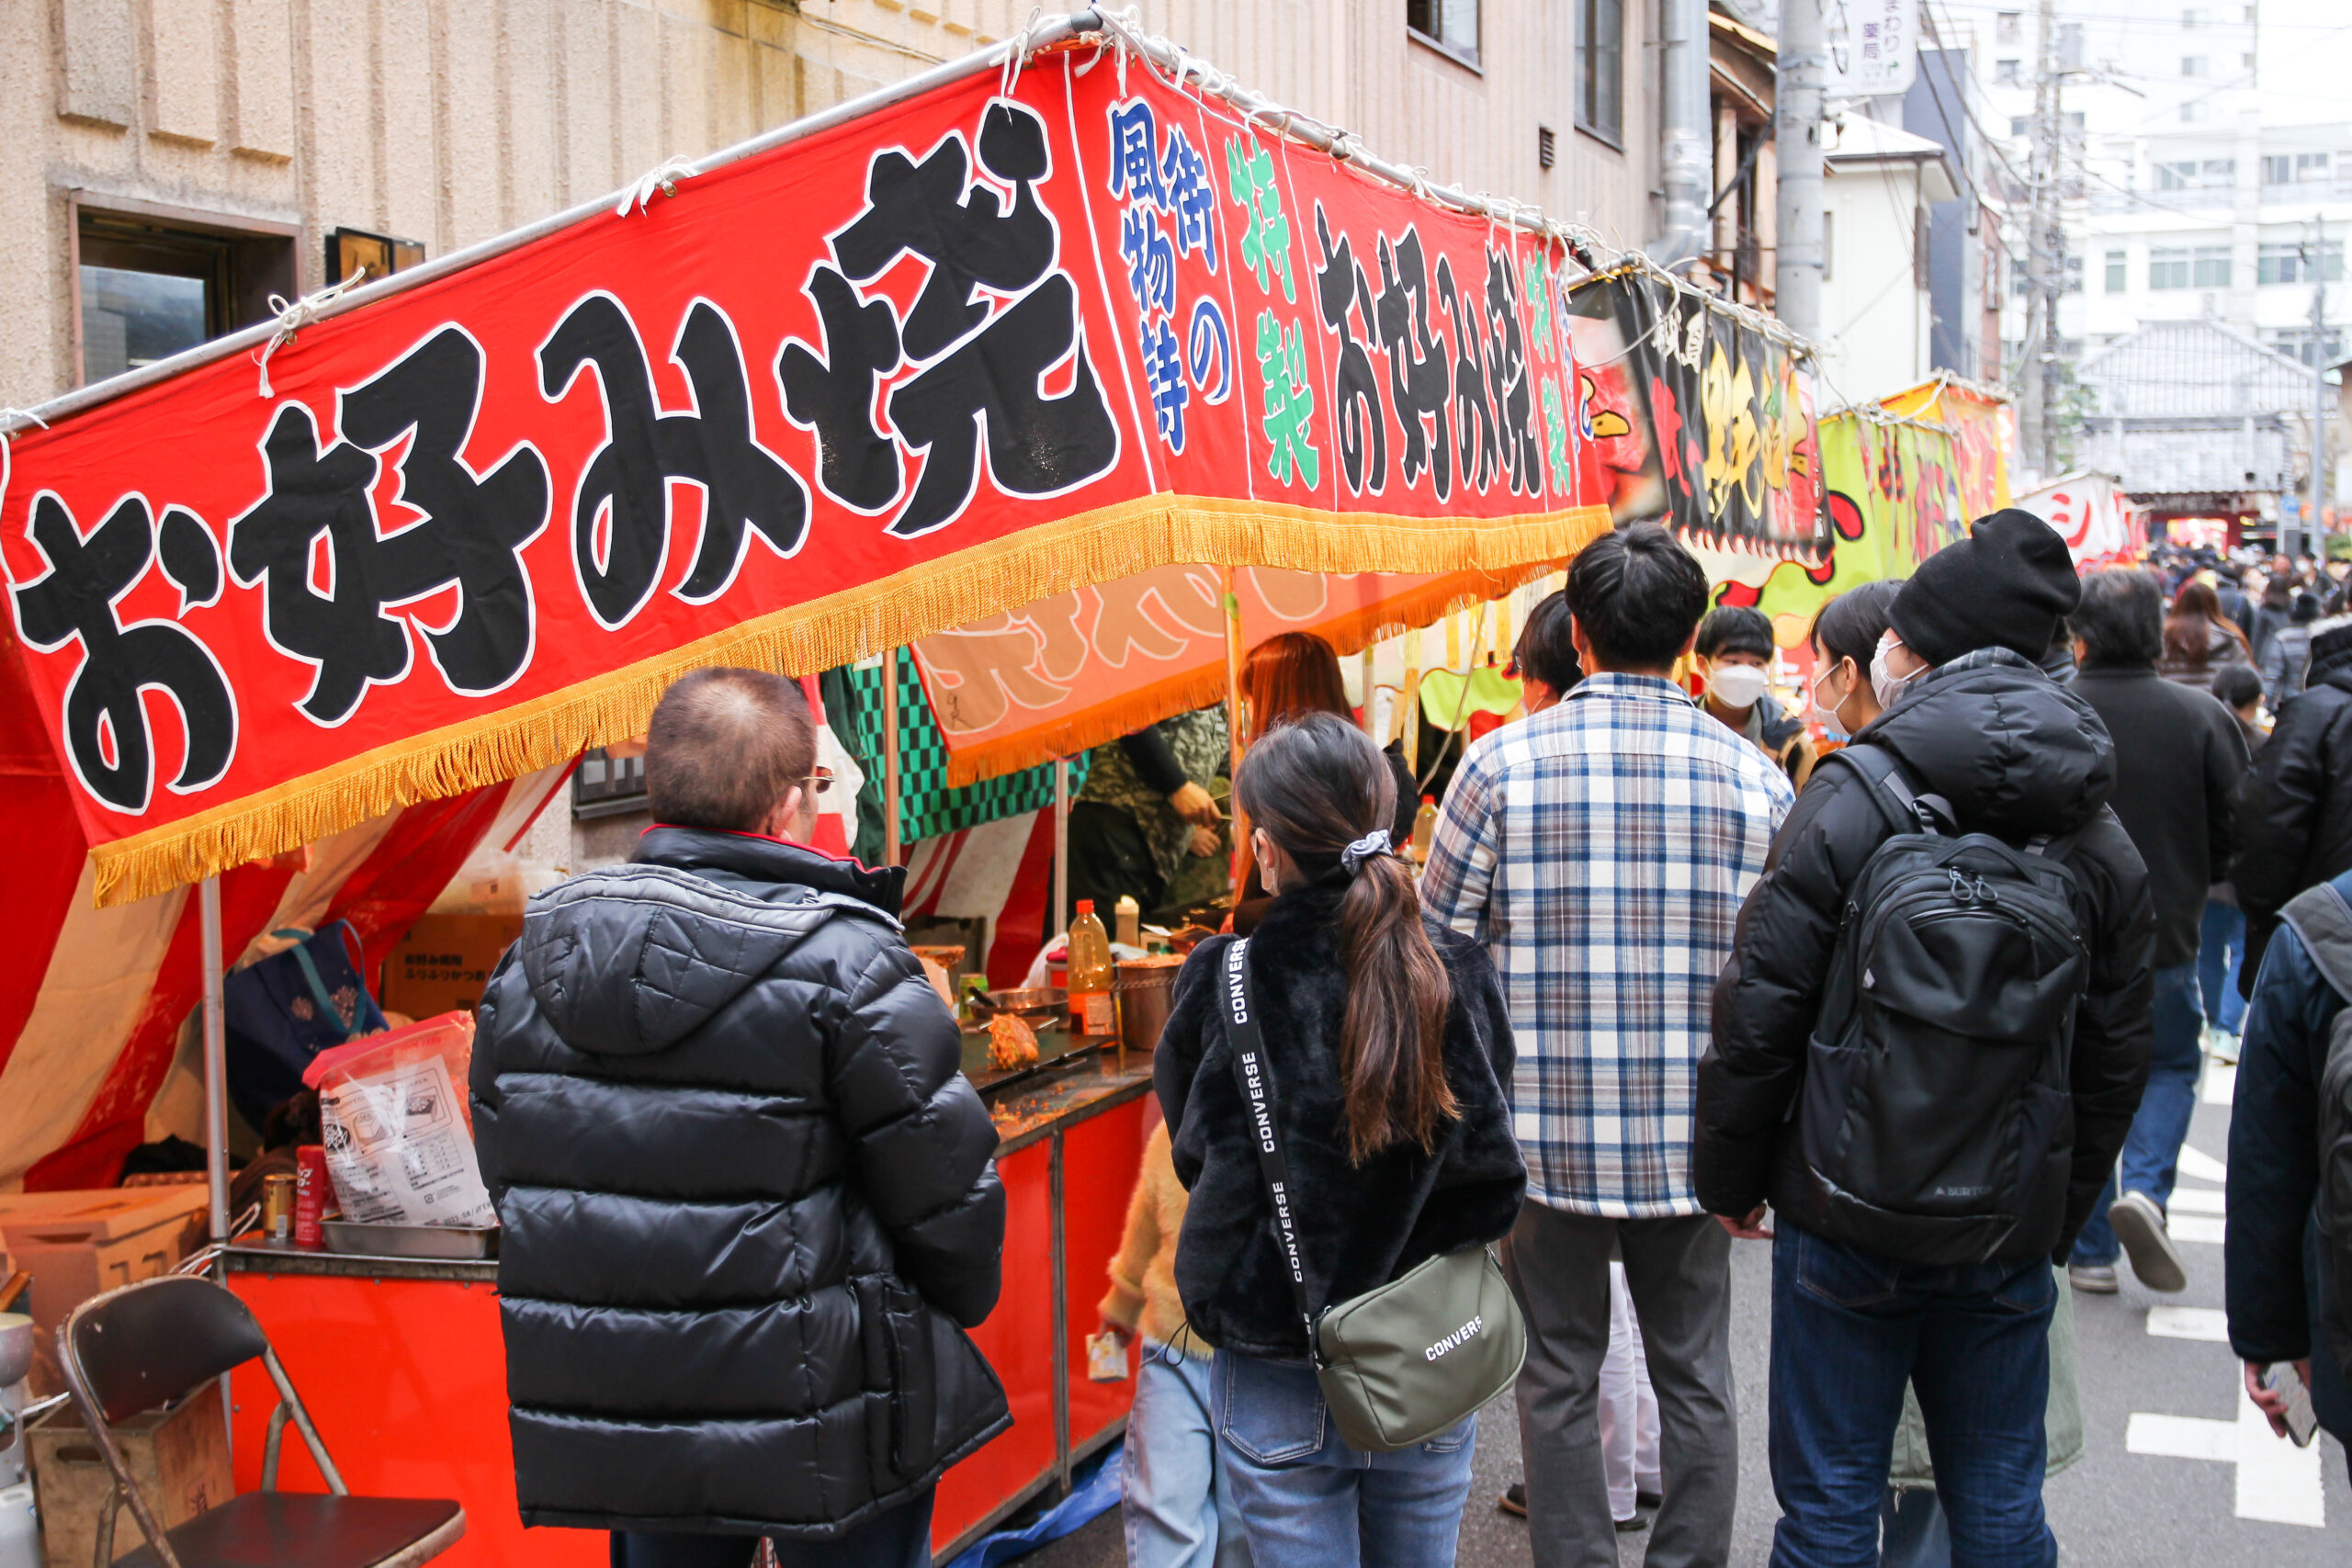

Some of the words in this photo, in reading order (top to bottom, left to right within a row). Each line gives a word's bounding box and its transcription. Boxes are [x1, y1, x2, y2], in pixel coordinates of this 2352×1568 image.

[1107, 96, 1189, 457] 風物詩
[1163, 124, 1231, 405] 街の
[1227, 132, 1319, 491] 特製
[1315, 198, 1544, 504] お好み焼
[9, 98, 1120, 815] お好み焼
[1242, 1052, 1275, 1154] CONVERSE
[1272, 1181, 1303, 1283] CONVERSE
[1425, 1314, 1483, 1361] CONVER
